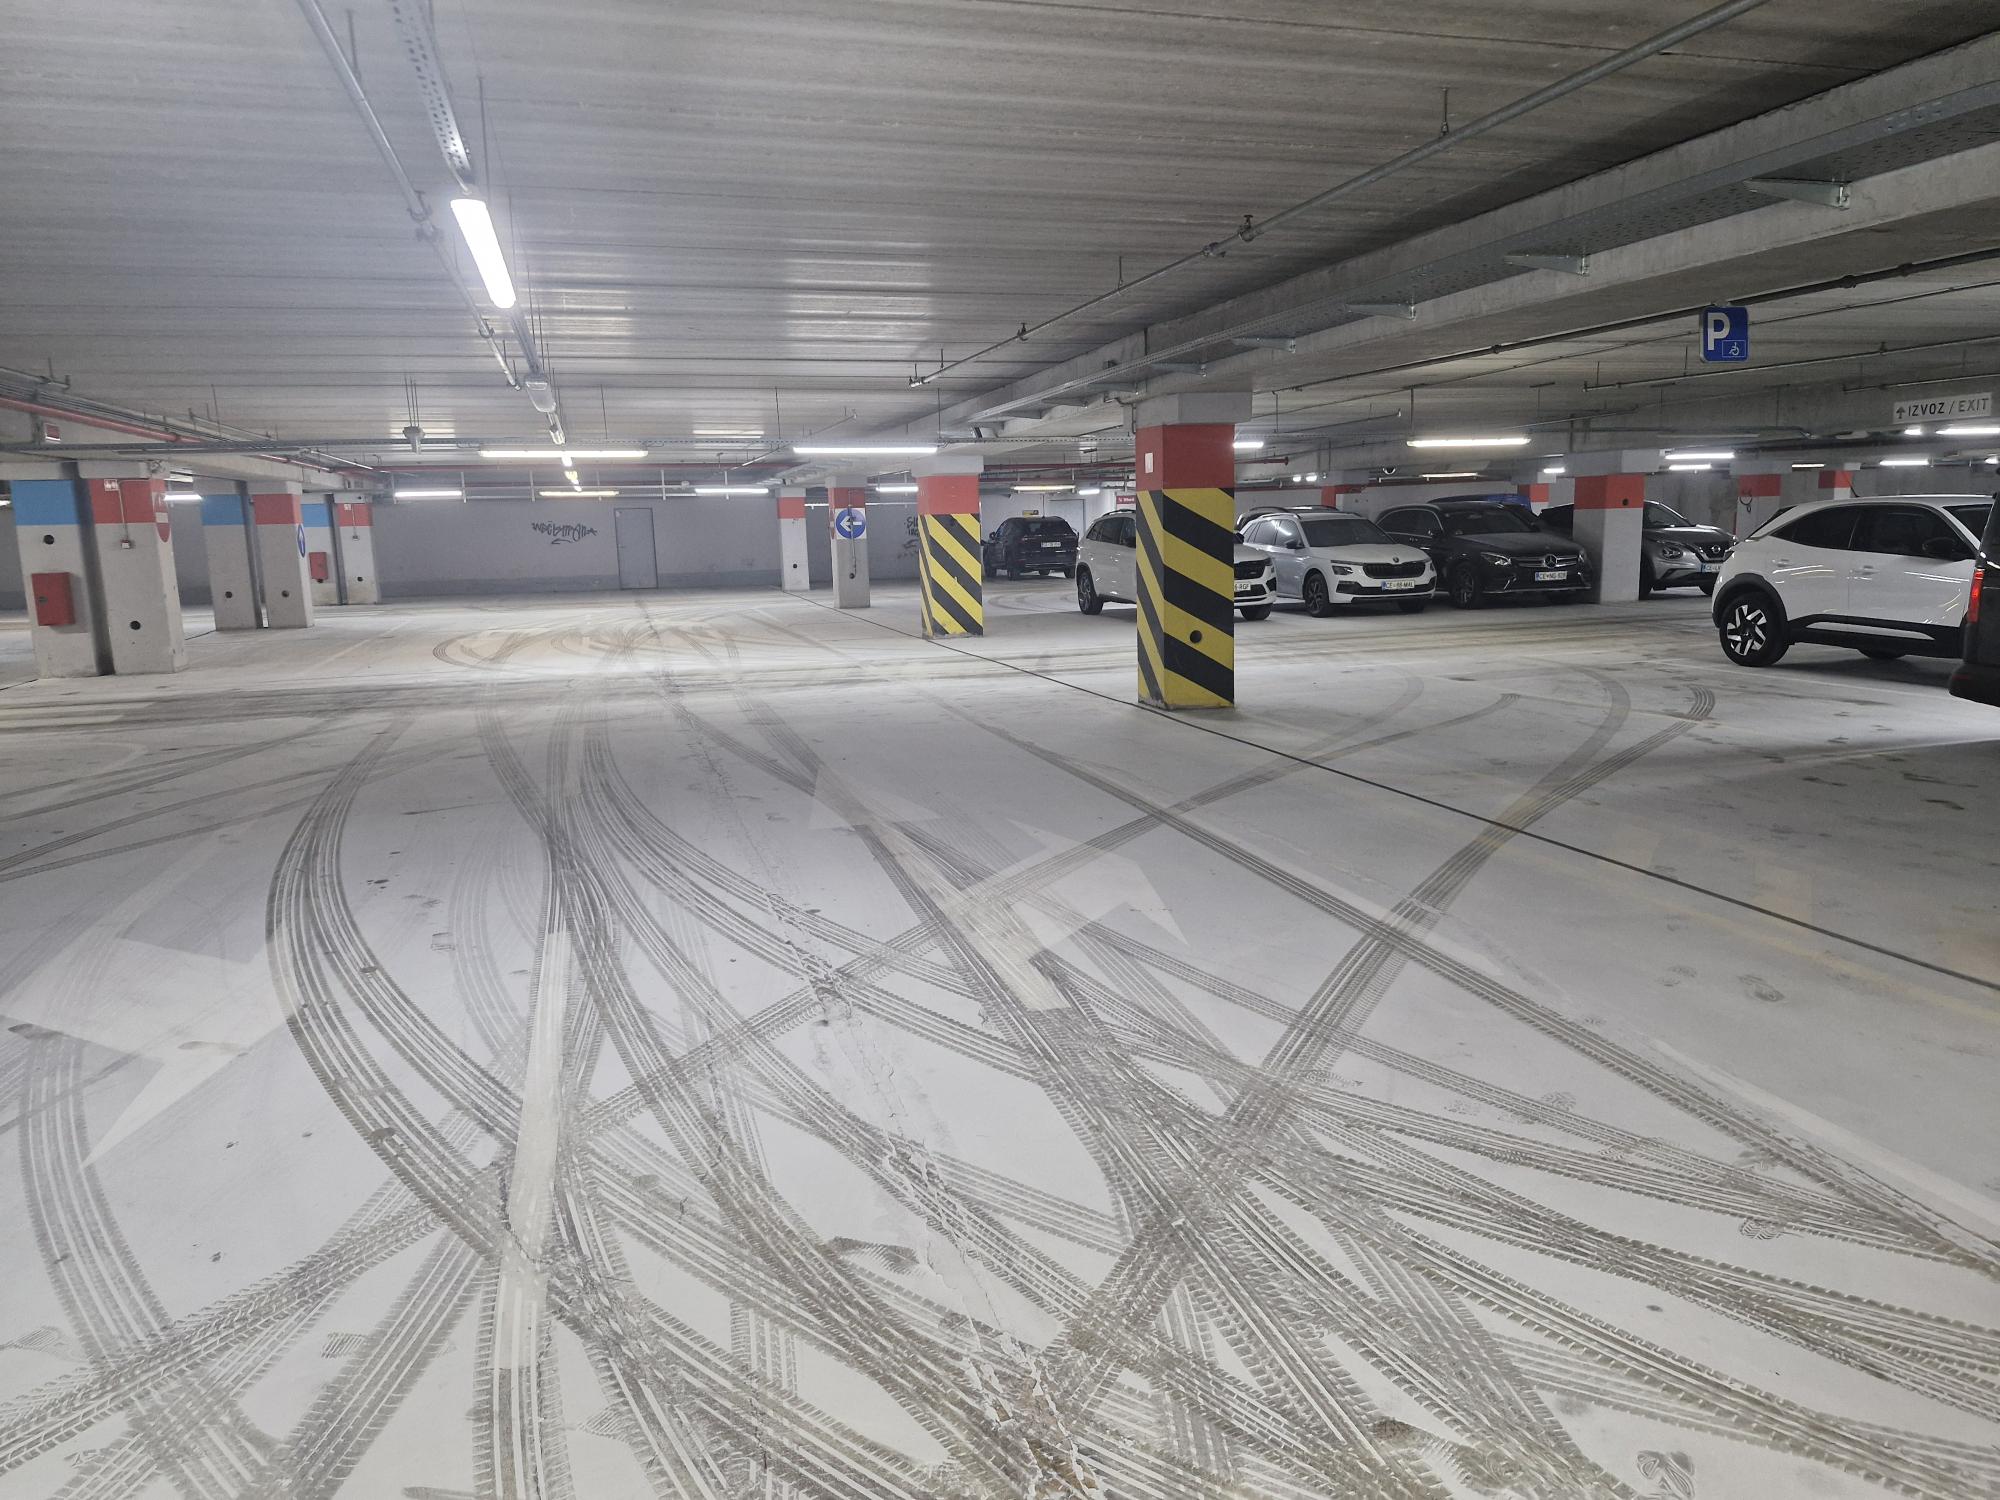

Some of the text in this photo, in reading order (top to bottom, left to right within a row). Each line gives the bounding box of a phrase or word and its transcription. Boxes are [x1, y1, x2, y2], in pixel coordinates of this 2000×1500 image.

[1707, 312, 1730, 351] P
[1908, 402, 1945, 417] IZVOZ
[1958, 398, 1989, 412] EXIT
